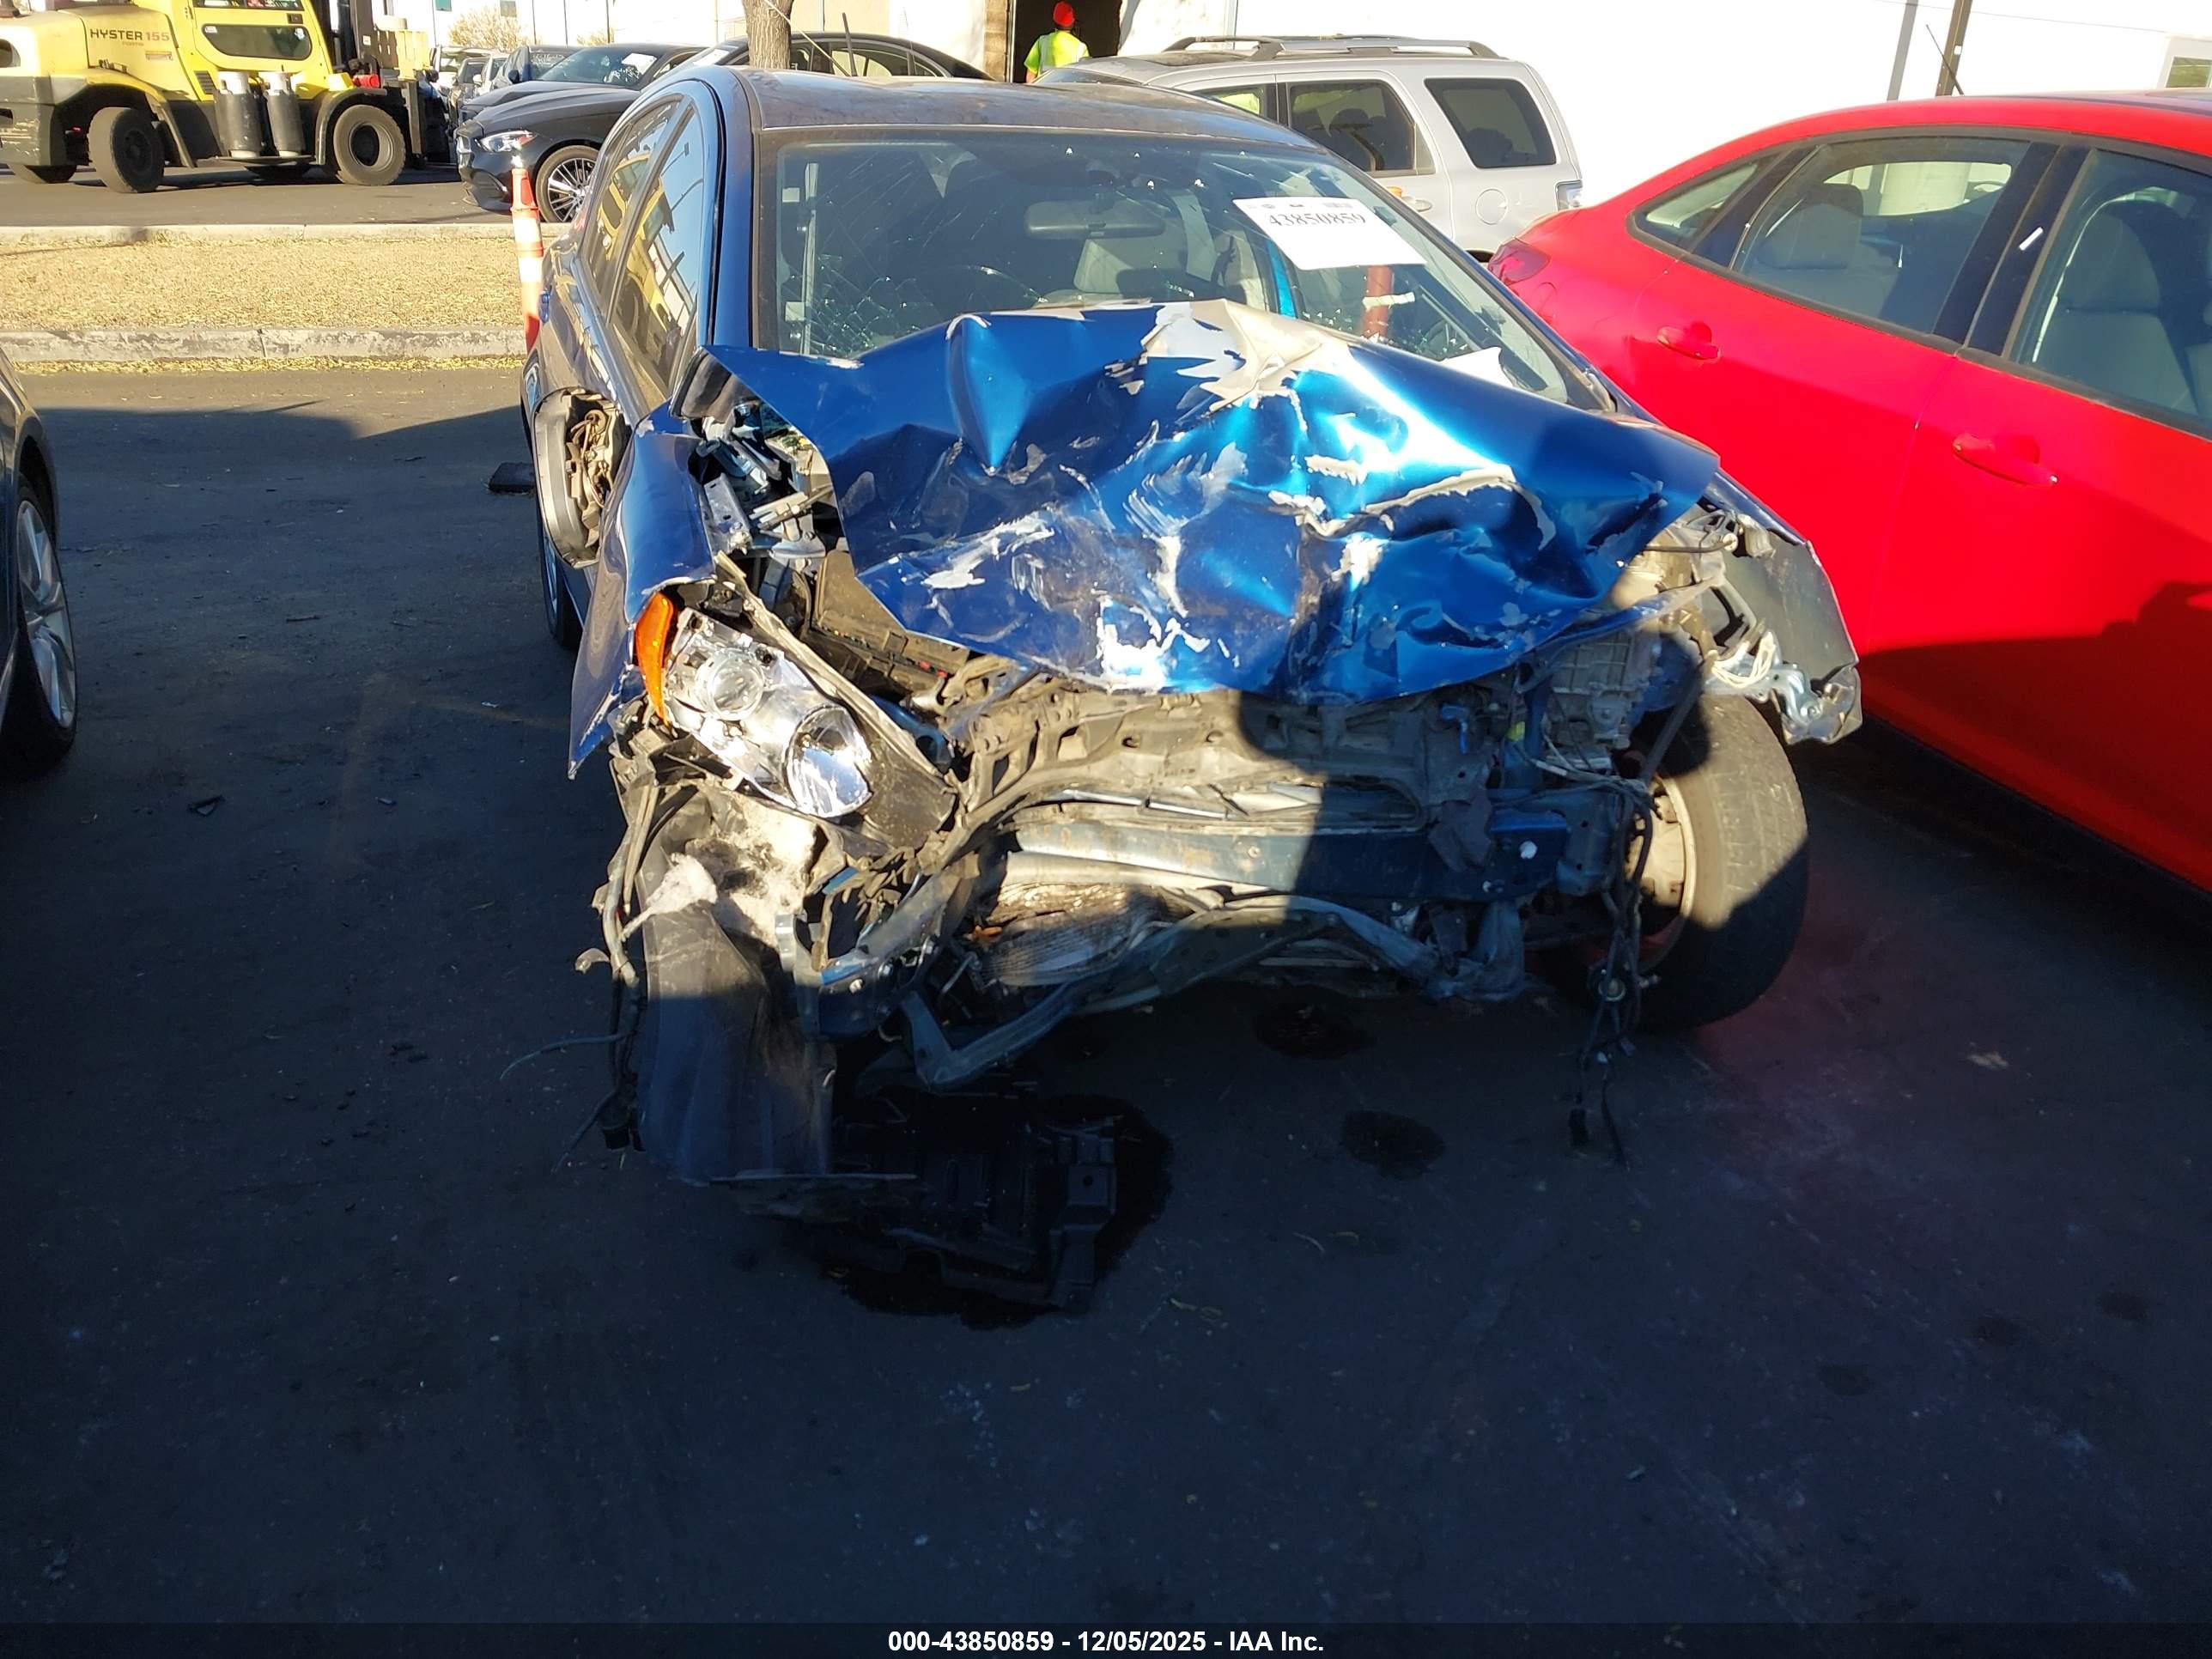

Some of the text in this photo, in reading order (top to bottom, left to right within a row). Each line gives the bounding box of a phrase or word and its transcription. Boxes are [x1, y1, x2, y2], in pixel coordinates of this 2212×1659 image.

[90, 28, 170, 41] HYSTER 155
[1269, 214, 1366, 227] 43850859
